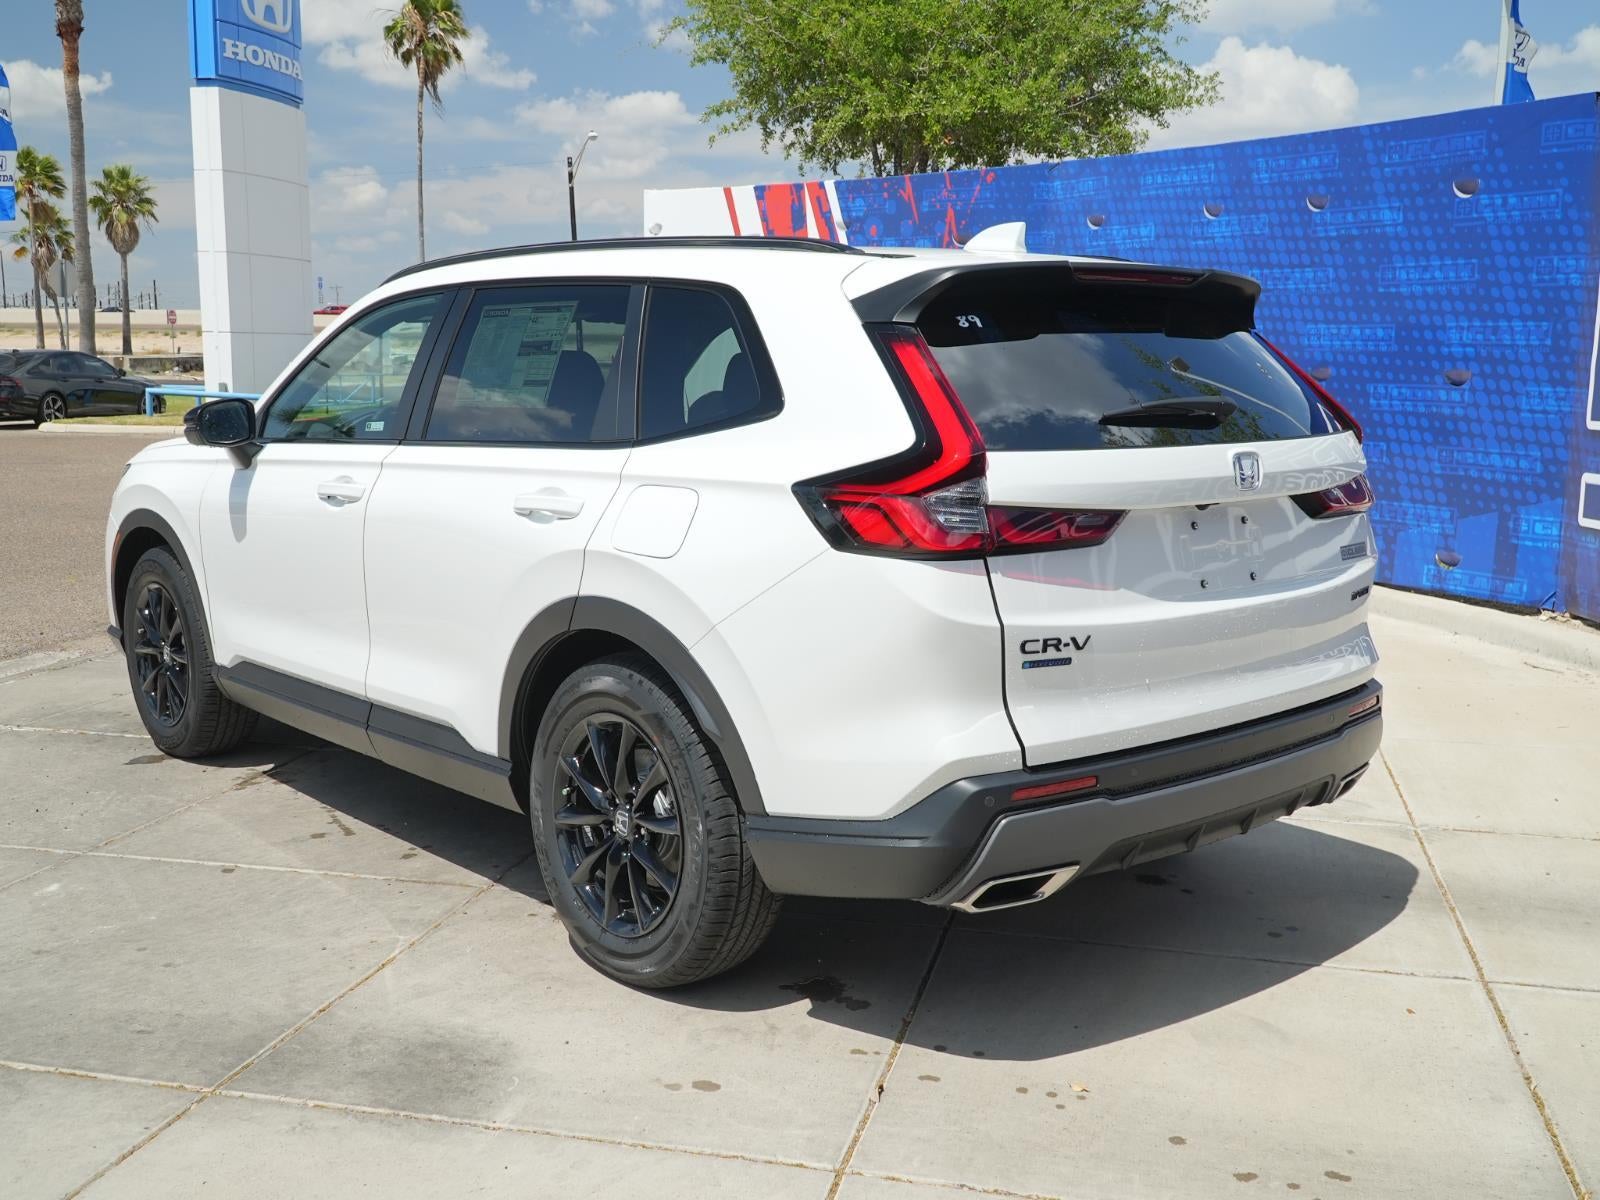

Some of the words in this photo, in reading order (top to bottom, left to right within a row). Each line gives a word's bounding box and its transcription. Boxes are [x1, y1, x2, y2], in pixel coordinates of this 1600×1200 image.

[223, 38, 303, 80] HONDA
[955, 314, 983, 328] 89
[1019, 634, 1092, 655] CR-V
